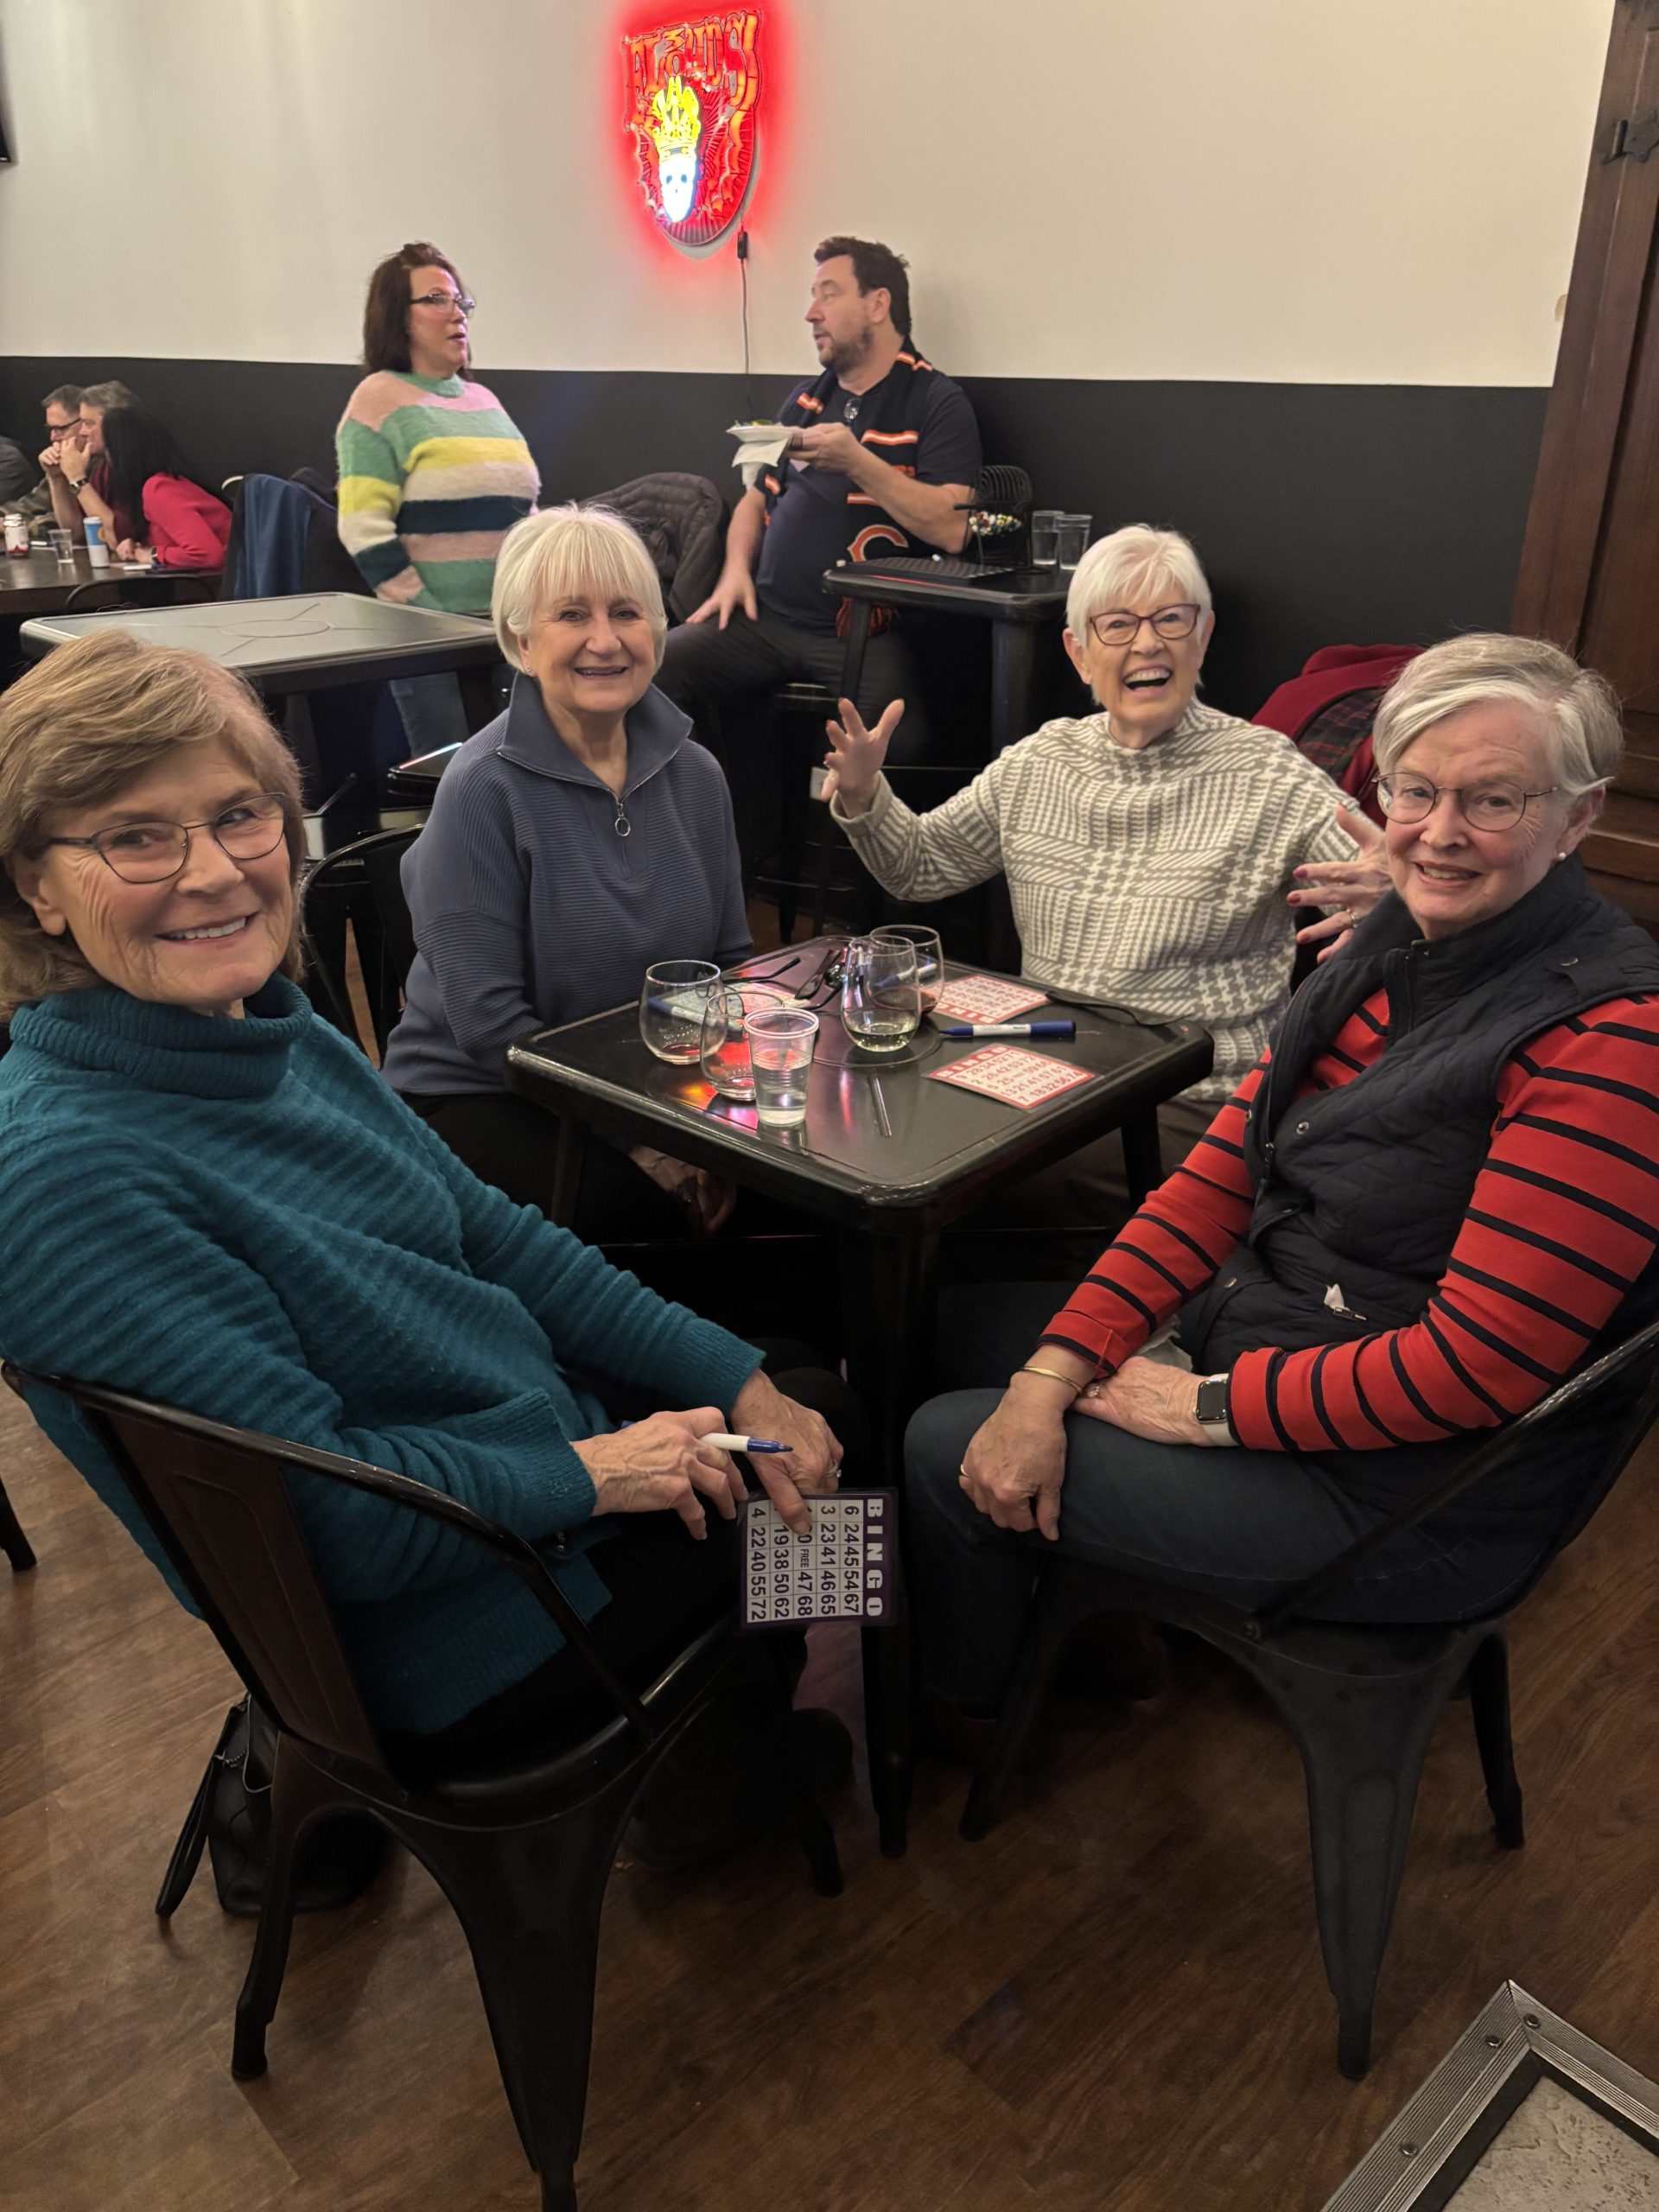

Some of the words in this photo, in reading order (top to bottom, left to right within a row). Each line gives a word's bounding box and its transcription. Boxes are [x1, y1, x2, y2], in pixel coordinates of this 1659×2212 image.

[753, 1509, 766, 1518] 4
[845, 1506, 859, 1515] 6
[752, 1528, 766, 1548] 22
[774, 1526, 789, 1545] 19
[798, 1525, 812, 1543] 0
[821, 1524, 836, 1542] 23
[844, 1524, 859, 1542] 24
[752, 1552, 766, 1572] 40
[774, 1549, 789, 1569] 38
[821, 1547, 836, 1566] 41
[844, 1547, 859, 1567] 45
[867, 1499, 883, 1617] BINGO
[752, 1576, 766, 1597] 55
[775, 1574, 789, 1593] 50
[798, 1573, 812, 1592] 47
[821, 1571, 836, 1591] 46
[844, 1571, 858, 1590] 54
[752, 1600, 766, 1620] 72
[775, 1599, 789, 1618] 62
[798, 1596, 812, 1616] 68
[821, 1595, 836, 1614] 65
[844, 1594, 858, 1613] 67
